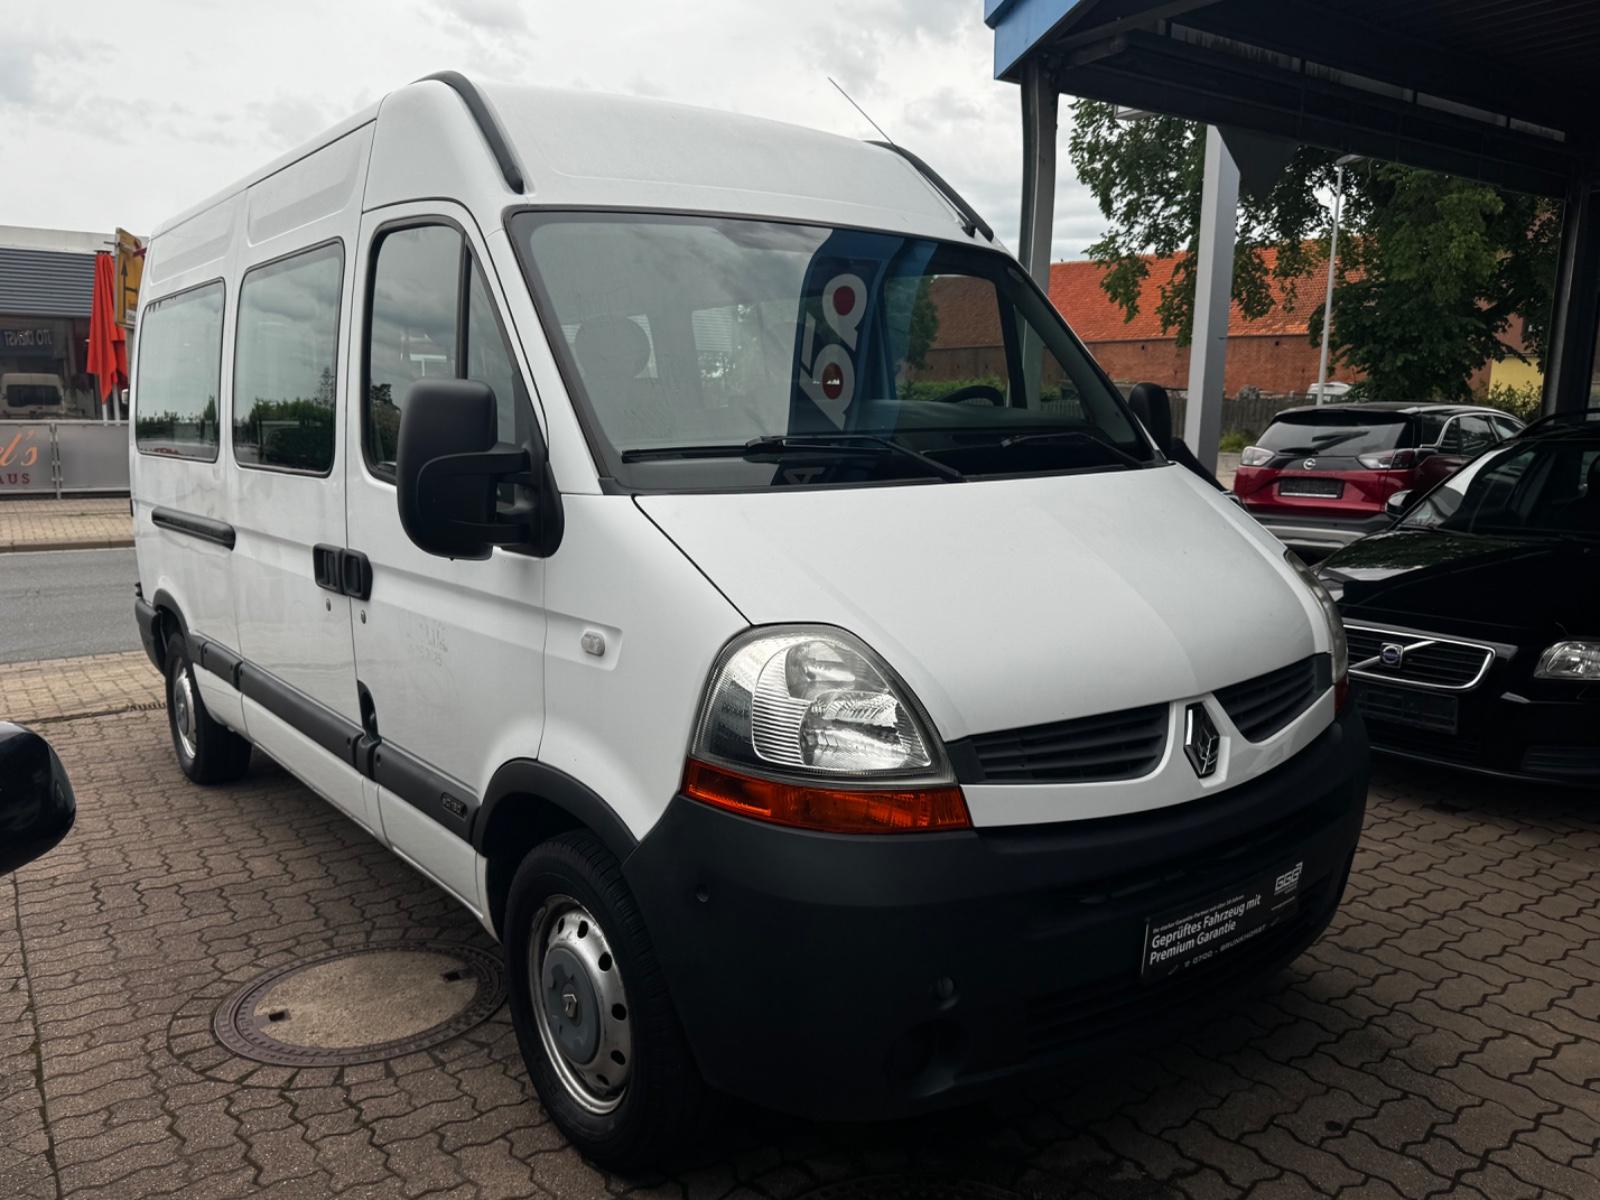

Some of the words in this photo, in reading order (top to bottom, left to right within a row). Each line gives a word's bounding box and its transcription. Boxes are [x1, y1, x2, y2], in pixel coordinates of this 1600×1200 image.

[1149, 940, 1195, 965] Premium
[1197, 919, 1236, 945] Garantie
[1152, 921, 1202, 949] Geprüftes
[1203, 903, 1245, 928] Fahrzeug
[1246, 894, 1261, 910] mit
